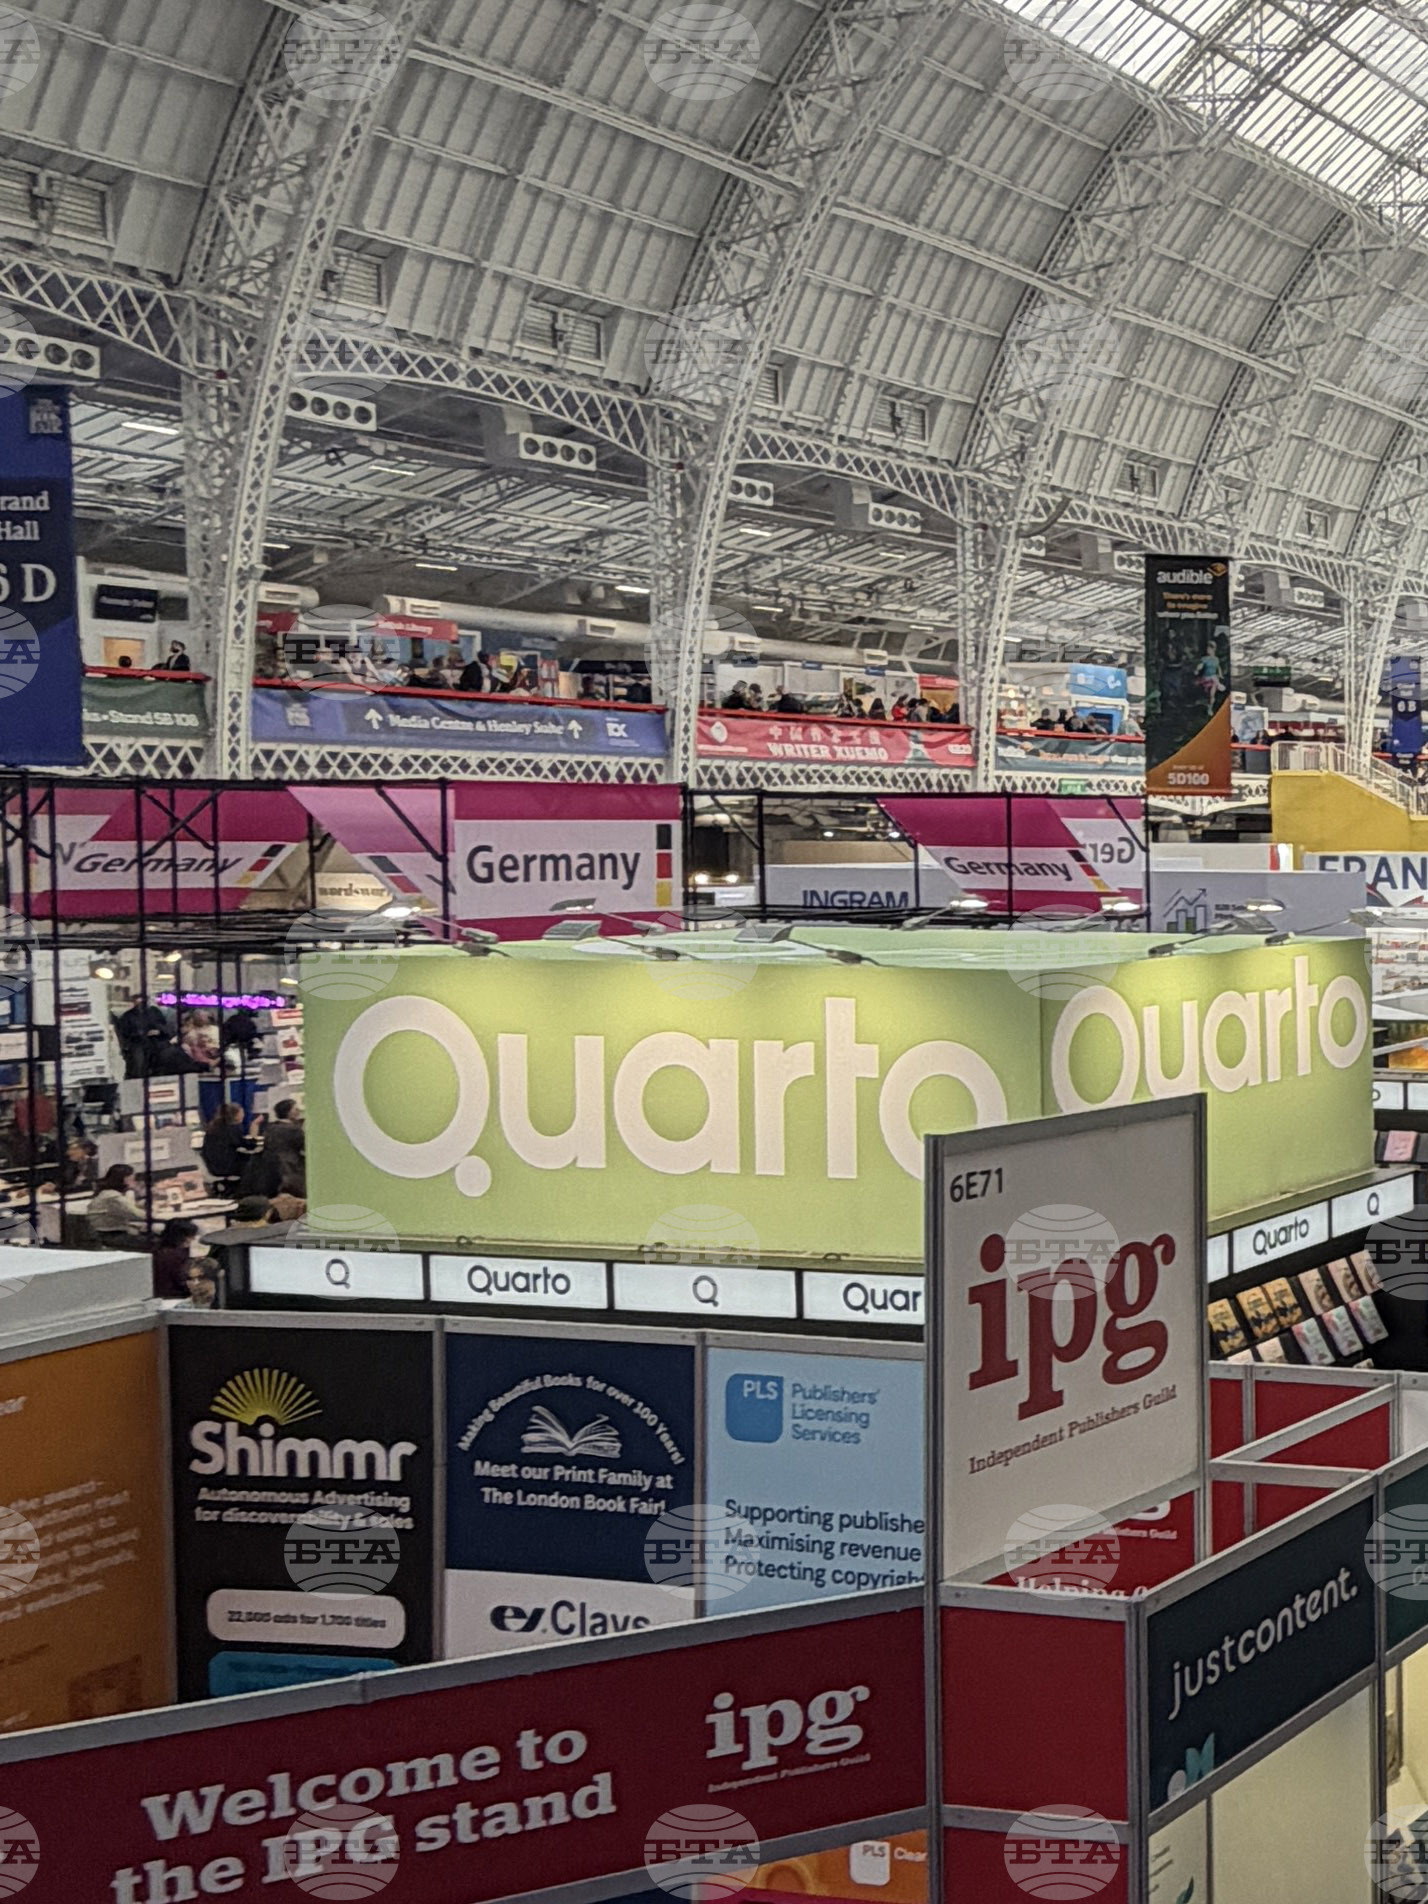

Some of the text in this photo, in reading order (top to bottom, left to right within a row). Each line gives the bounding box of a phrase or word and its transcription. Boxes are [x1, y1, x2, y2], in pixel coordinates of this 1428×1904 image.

[1157, 569, 1213, 584] audible
[768, 742, 832, 760] WRITER
[466, 844, 641, 892] Germany
[802, 890, 909, 911] INGRAM
[1051, 956, 1369, 1113] Quarto
[334, 995, 1008, 1197] Quarto
[949, 1167, 1004, 1203] 6E71
[467, 1265, 571, 1298] Quarto
[968, 1233, 1177, 1421] ipg
[743, 1379, 778, 1400] PLS
[791, 1403, 870, 1429] Licensing
[969, 1384, 1178, 1475] Independent Publishers Guild
[189, 1420, 418, 1482] Shimmr
[791, 1424, 861, 1445] Services
[473, 1459, 674, 1492] Meet our Print Family at
[480, 1487, 666, 1516] The London Book Fair!
[725, 1499, 835, 1533] Supporting
[724, 1527, 923, 1563] Maximising revenue
[724, 1555, 826, 1588] Protecting
[1168, 1566, 1358, 1721] justcontent.
[705, 1684, 870, 1771] ipg
[141, 1727, 588, 1841] Welcome to
[262, 1817, 400, 1883] IPG
[414, 1773, 616, 1853] stand
